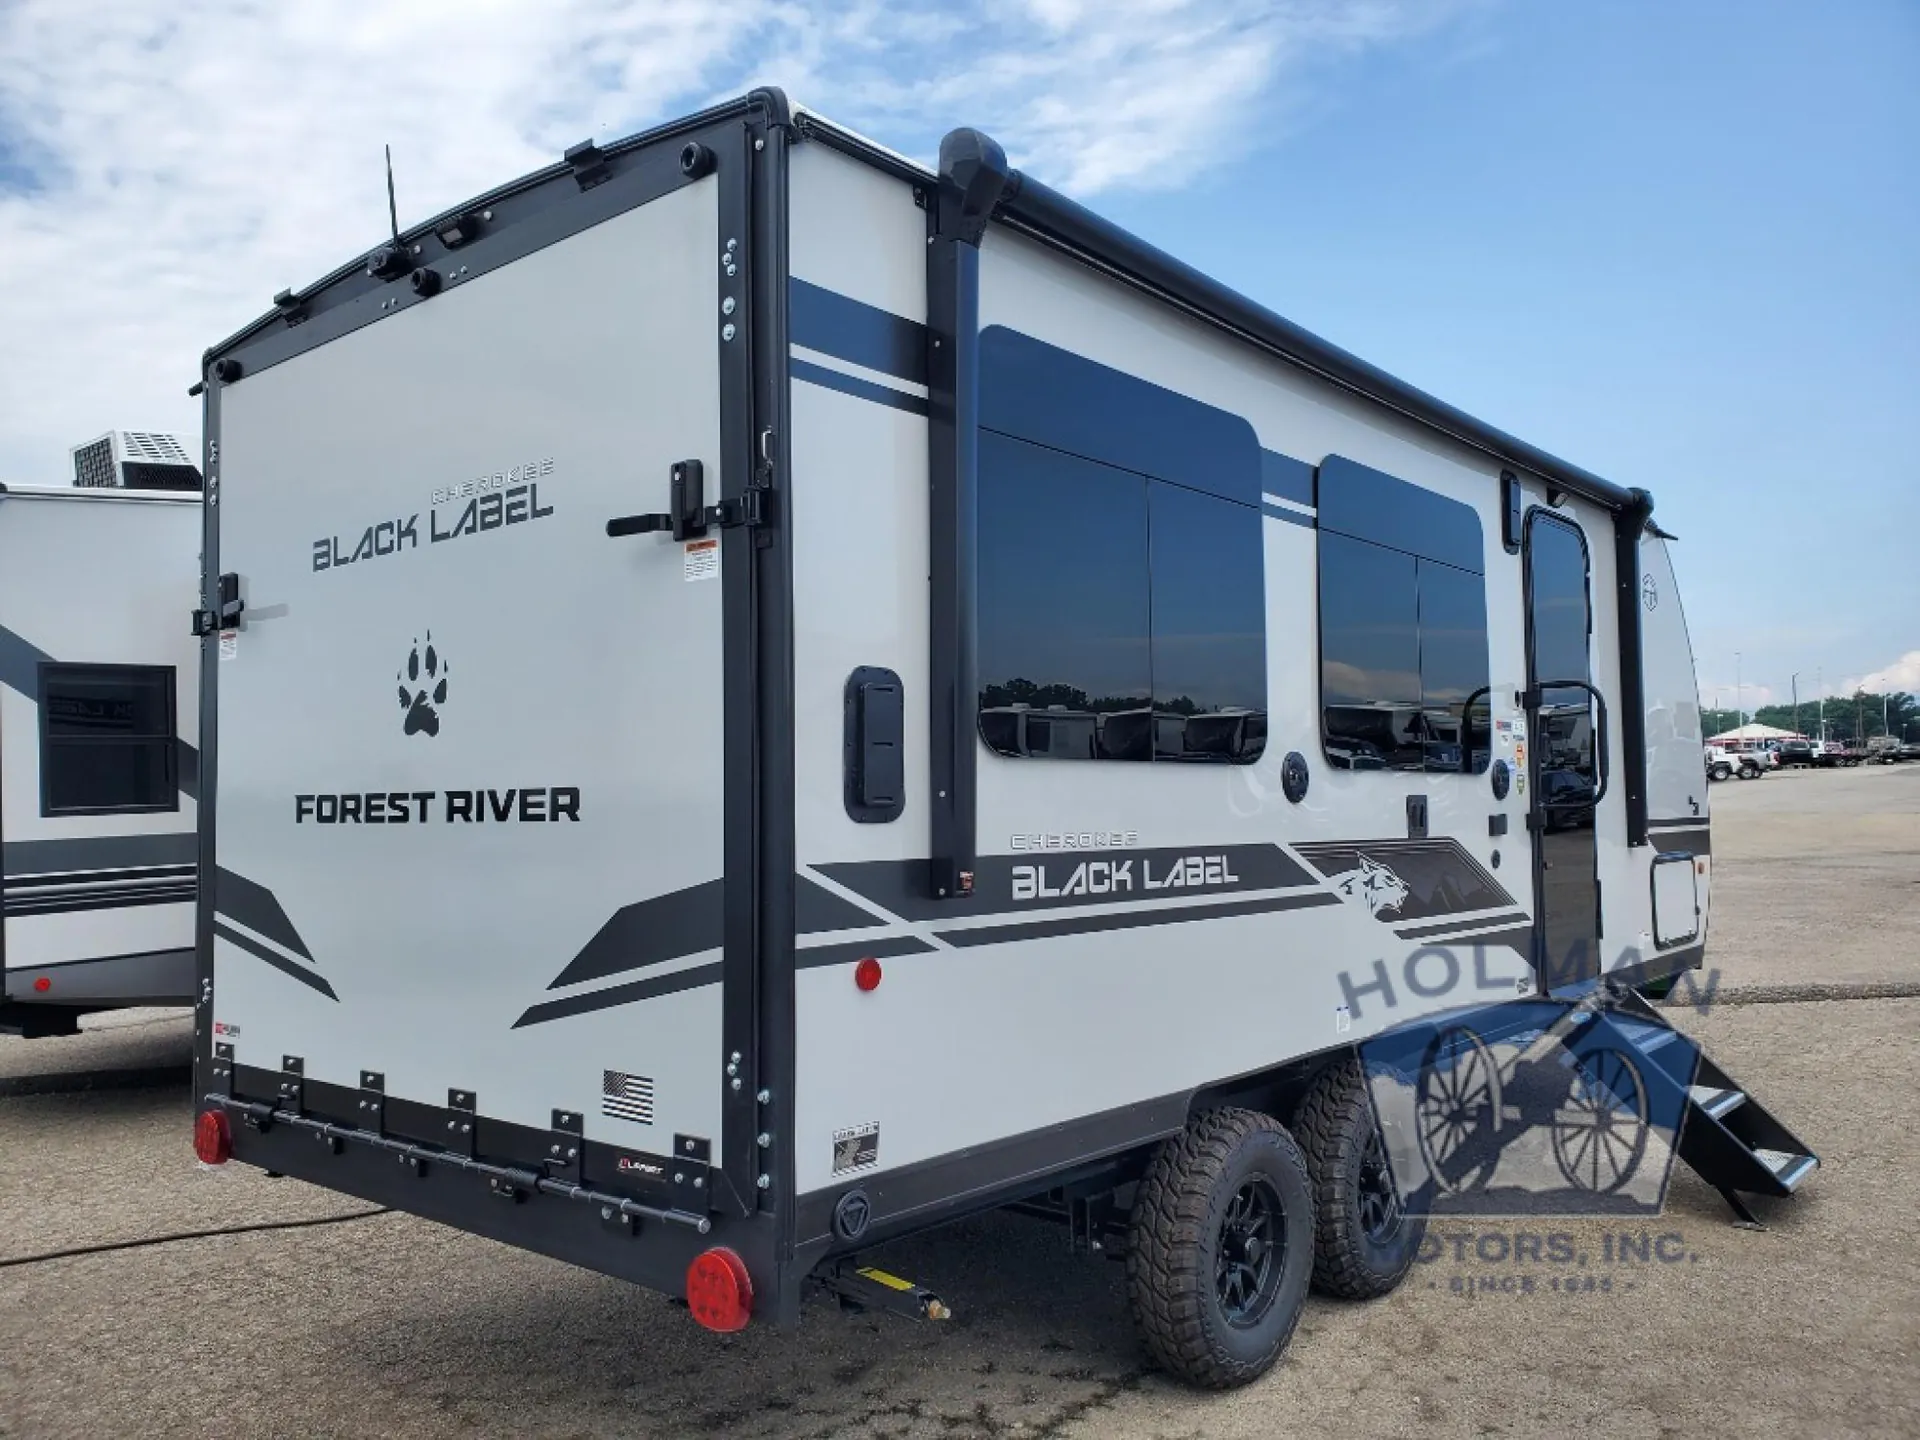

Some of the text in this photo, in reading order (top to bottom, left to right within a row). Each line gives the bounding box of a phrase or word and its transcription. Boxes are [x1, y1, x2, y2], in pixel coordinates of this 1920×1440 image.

[432, 457, 554, 504] CHEROKEE
[312, 483, 554, 573] BLACK LABEL
[295, 786, 581, 824] FOREST RIVER
[1011, 831, 1138, 850] CHEROKEE
[1012, 855, 1240, 900] BLACK LABEL
